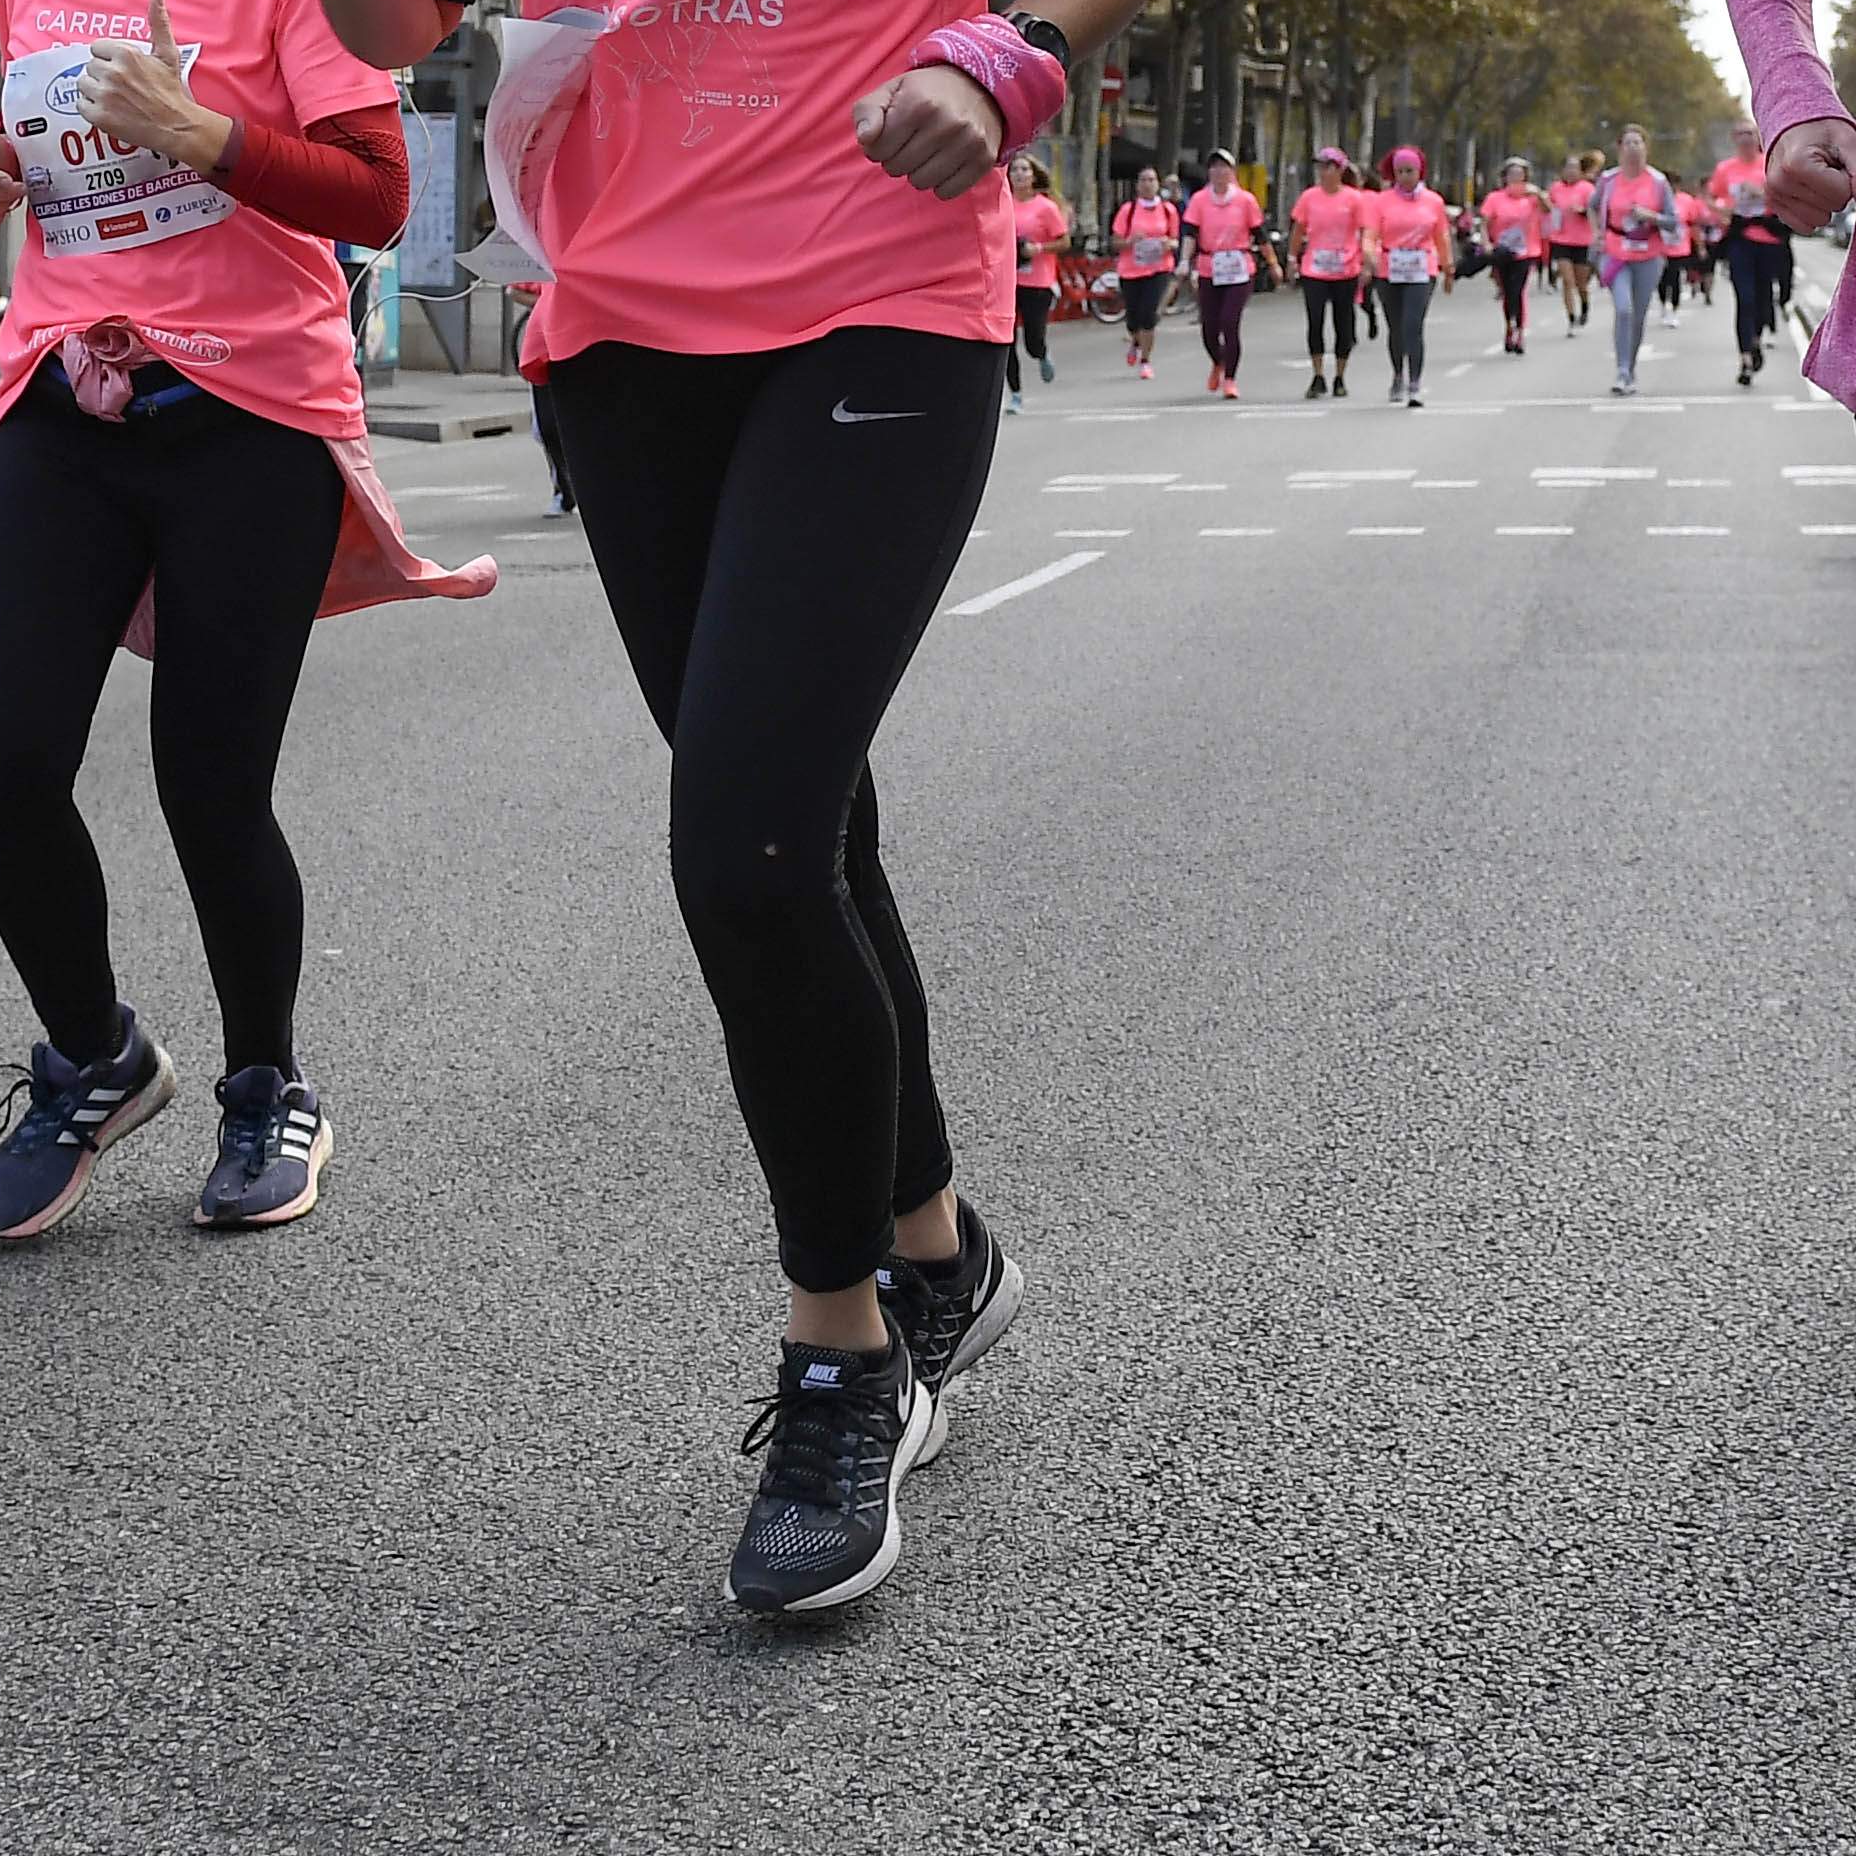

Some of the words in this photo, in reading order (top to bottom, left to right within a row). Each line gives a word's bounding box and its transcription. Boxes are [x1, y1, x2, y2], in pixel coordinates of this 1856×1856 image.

[737, 94, 780, 107] 2021
[85, 167, 126, 191] 2709
[60, 201, 73, 213] DE
[73, 197, 91, 211] LES
[93, 190, 126, 206] DONES
[128, 184, 145, 199] DE
[146, 172, 202, 194] BARCELO
[175, 196, 218, 216] ZURICH
[805, 1362, 841, 1382] NIKE
